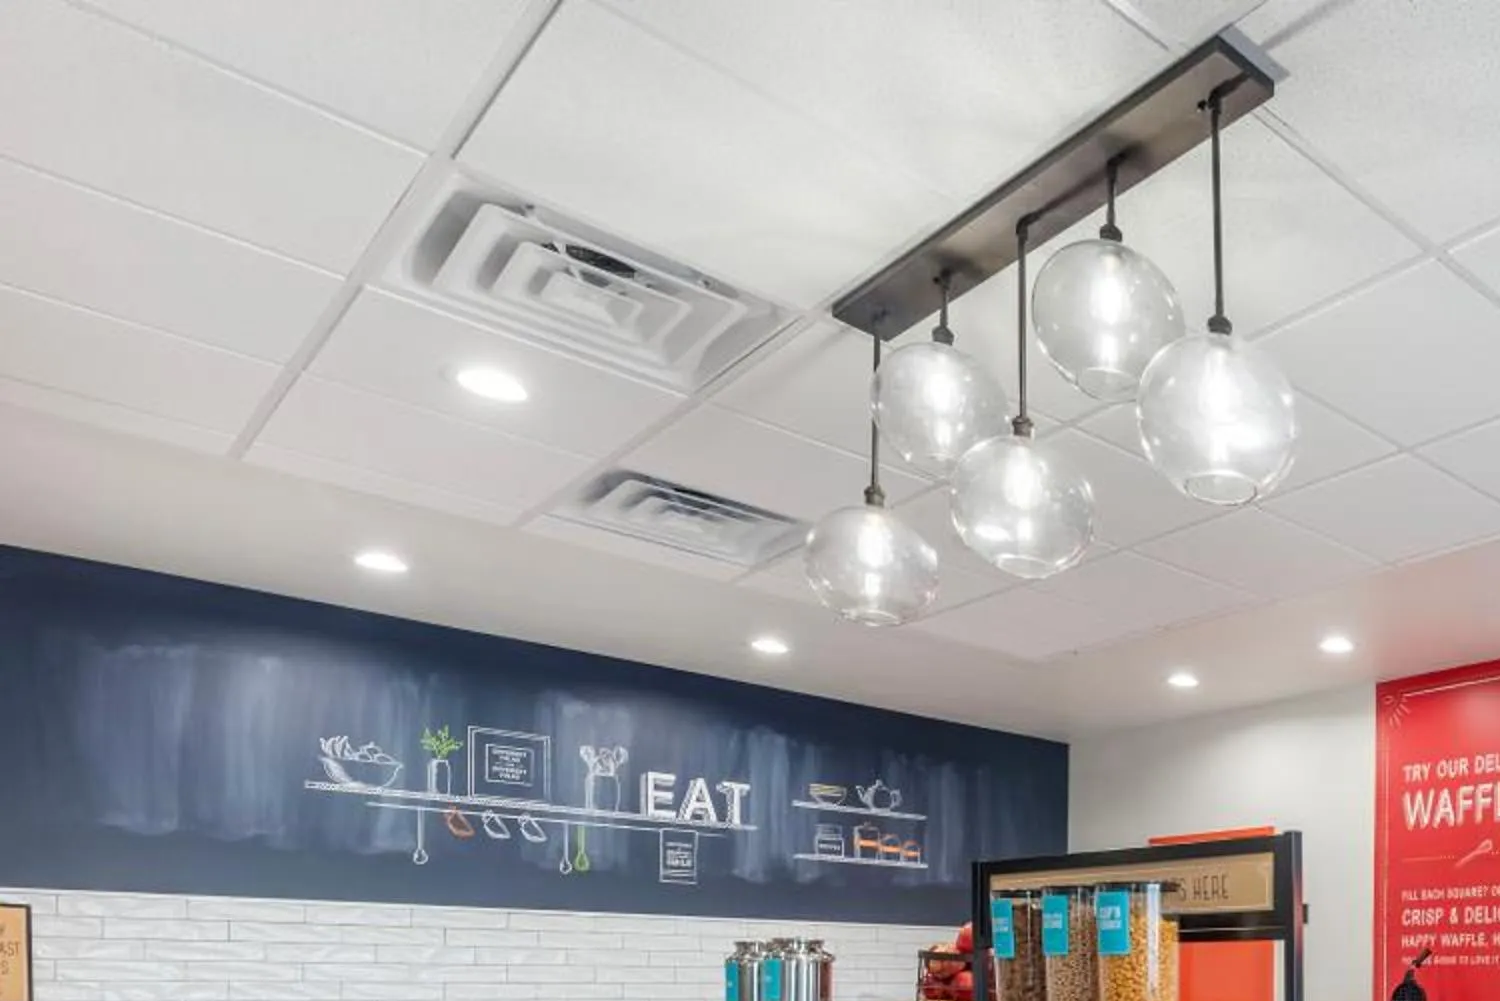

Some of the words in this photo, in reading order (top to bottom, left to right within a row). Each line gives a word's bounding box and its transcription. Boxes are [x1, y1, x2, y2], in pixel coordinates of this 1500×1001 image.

[1402, 762, 1431, 783] TRY
[1436, 757, 1469, 779] OUR
[640, 771, 751, 829] EAT
[1193, 874, 1229, 901] HERE
[1401, 907, 1444, 926] CRISP
[1449, 906, 1459, 925] &
[1401, 933, 1437, 948] HAPPY
